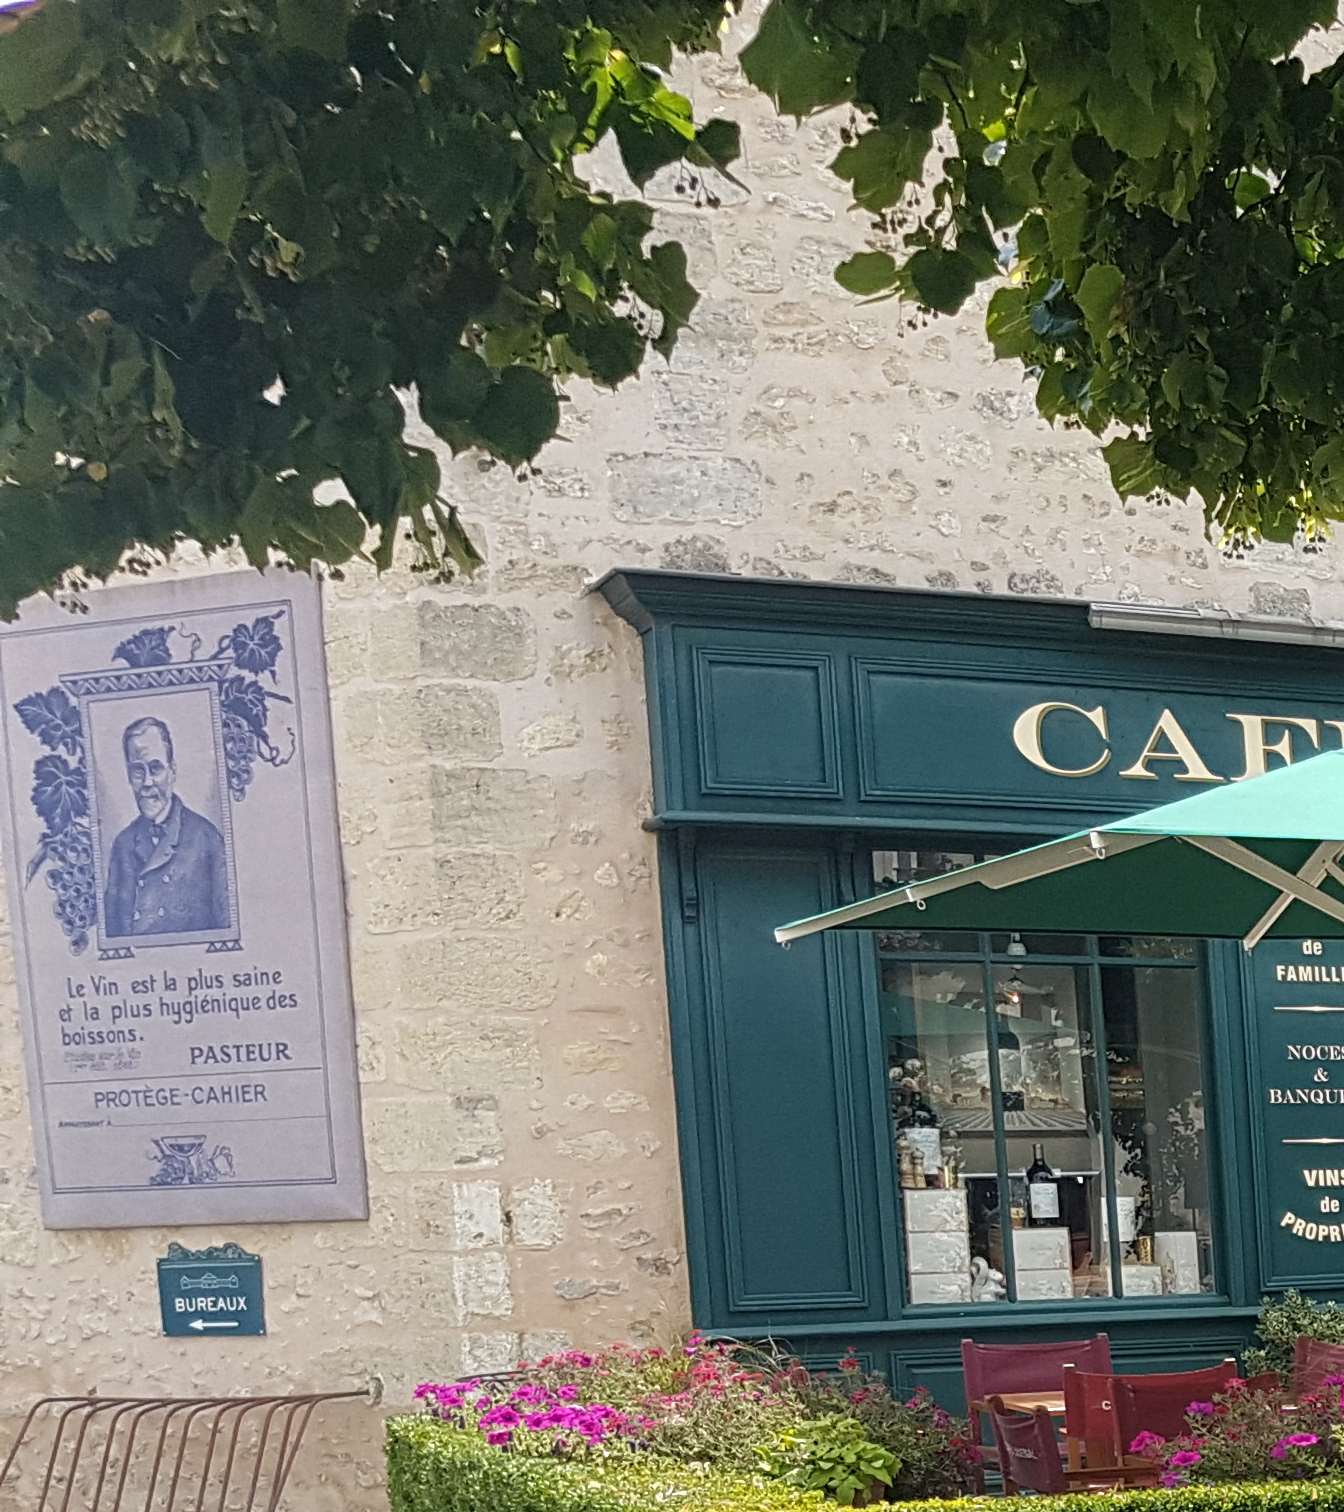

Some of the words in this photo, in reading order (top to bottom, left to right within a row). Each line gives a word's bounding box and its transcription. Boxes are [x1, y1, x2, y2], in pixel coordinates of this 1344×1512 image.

[1302, 939, 1323, 955] de
[67, 977, 86, 998] Le
[90, 975, 119, 996] Vin
[131, 974, 157, 994] est
[163, 970, 177, 991] la
[186, 968, 224, 997] plus
[232, 966, 283, 988] saine
[59, 1003, 73, 1022] et
[82, 1000, 100, 1021] la
[111, 998, 153, 1025] plus
[159, 992, 262, 1025] hygiénique
[266, 989, 298, 1010] des
[61, 1024, 144, 1046] boissons.
[189, 1042, 293, 1065] PASTEUR
[1313, 1067, 1329, 1082] &
[93, 1084, 268, 1109] PROTÈGE-CAHIER
[1320, 1196, 1340, 1213] de
[174, 1296, 248, 1313] BUREAUX
